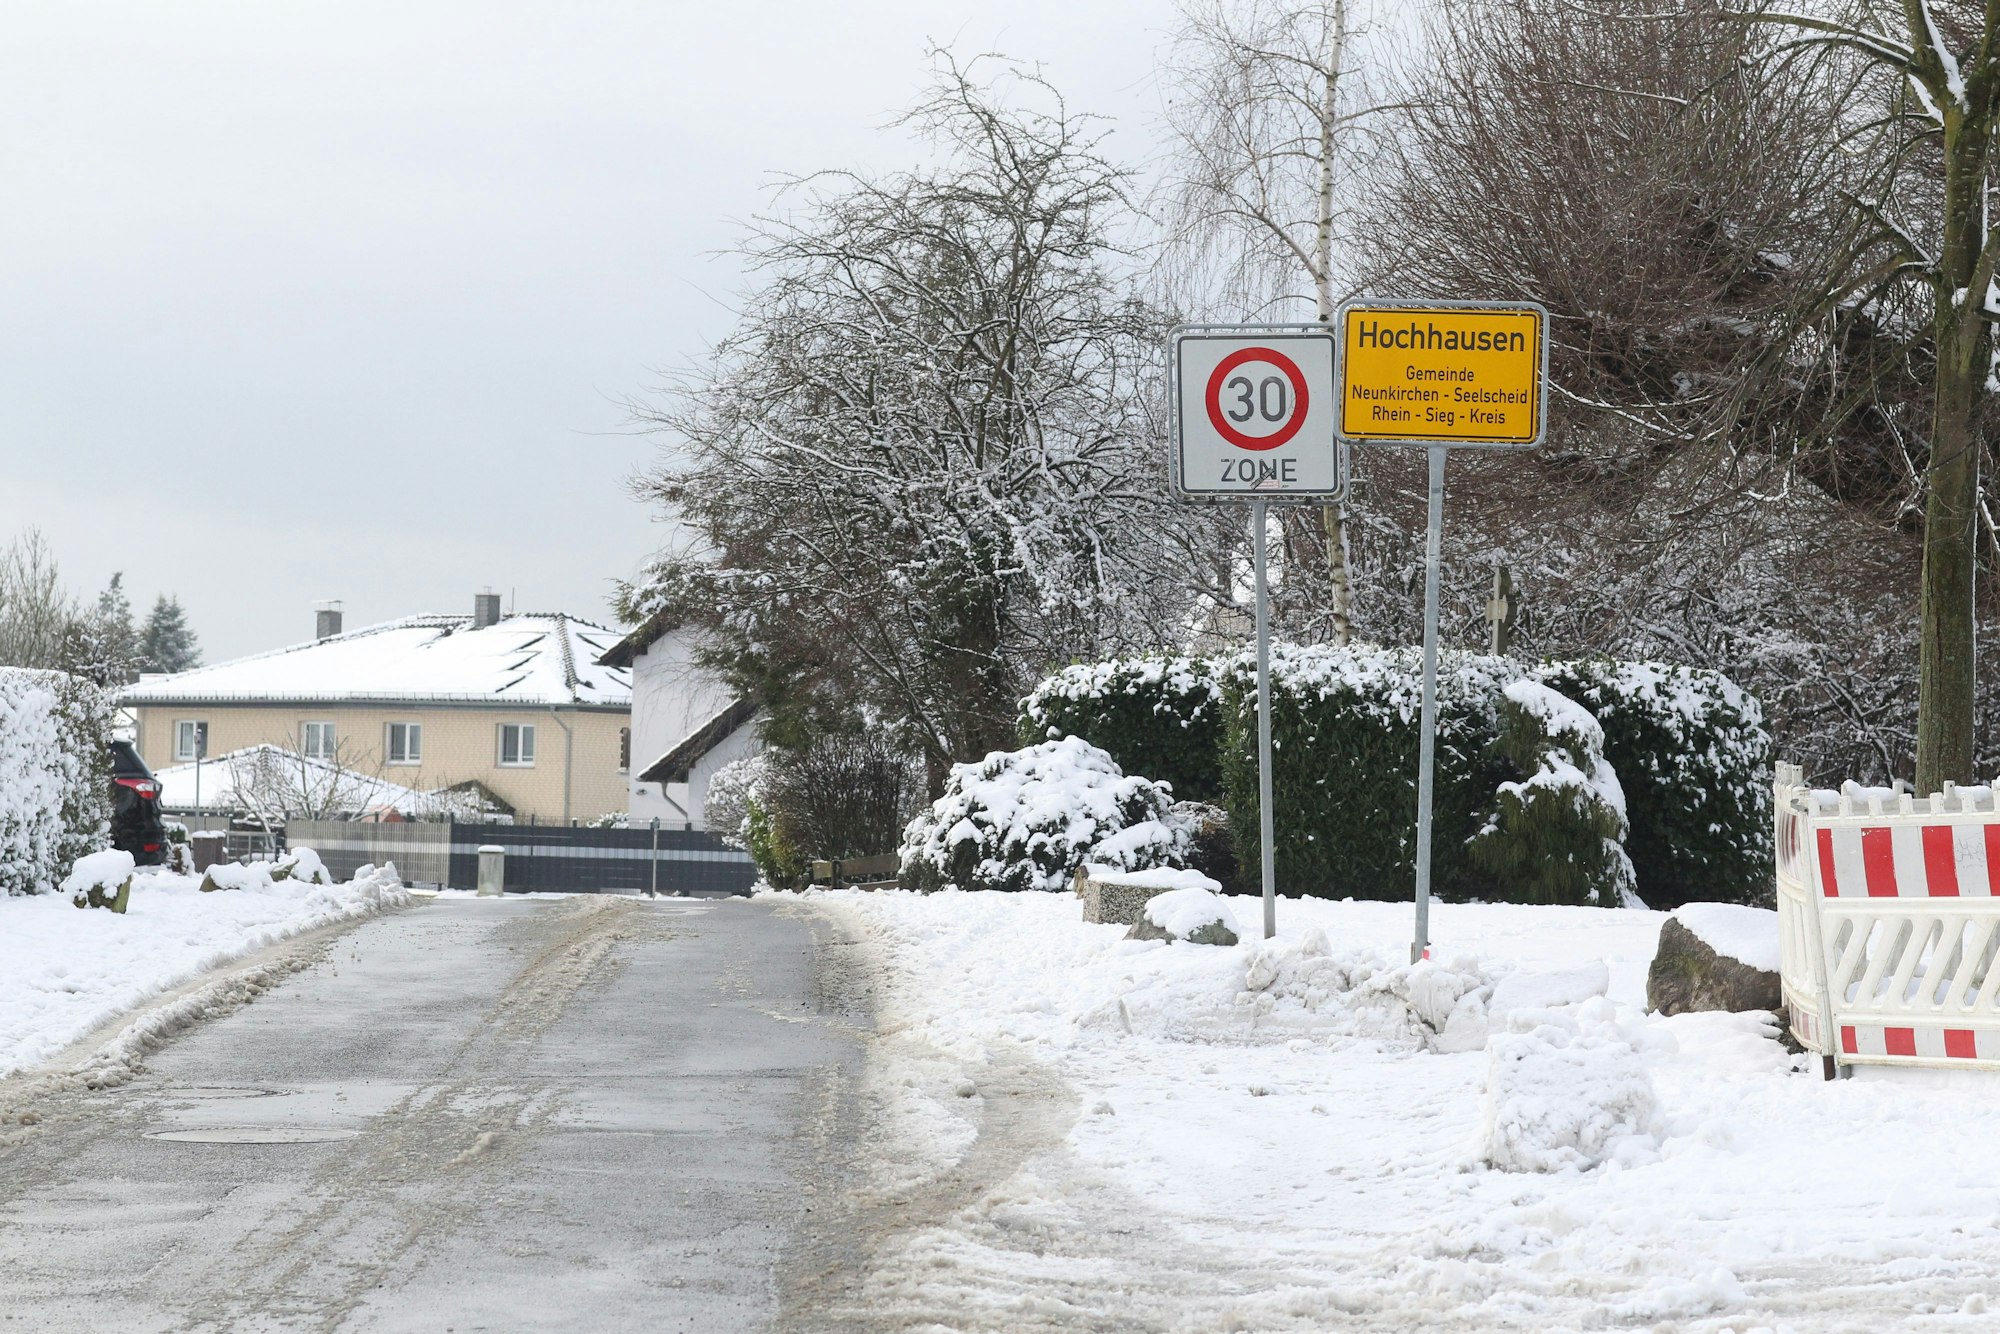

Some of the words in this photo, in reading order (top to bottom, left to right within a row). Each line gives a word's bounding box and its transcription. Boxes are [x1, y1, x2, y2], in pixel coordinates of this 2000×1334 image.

[1359, 321, 1525, 352] Hochhausen
[1406, 365, 1475, 382] Gemeinde
[1227, 376, 1287, 422] 30
[1352, 384, 1439, 402] Neunkirchen
[1454, 387, 1528, 404] Seelscheid
[1372, 405, 1411, 421] Rhein
[1425, 407, 1455, 427] Sieg
[1470, 408, 1506, 424] Kreis
[1220, 458, 1297, 482] ZONE
